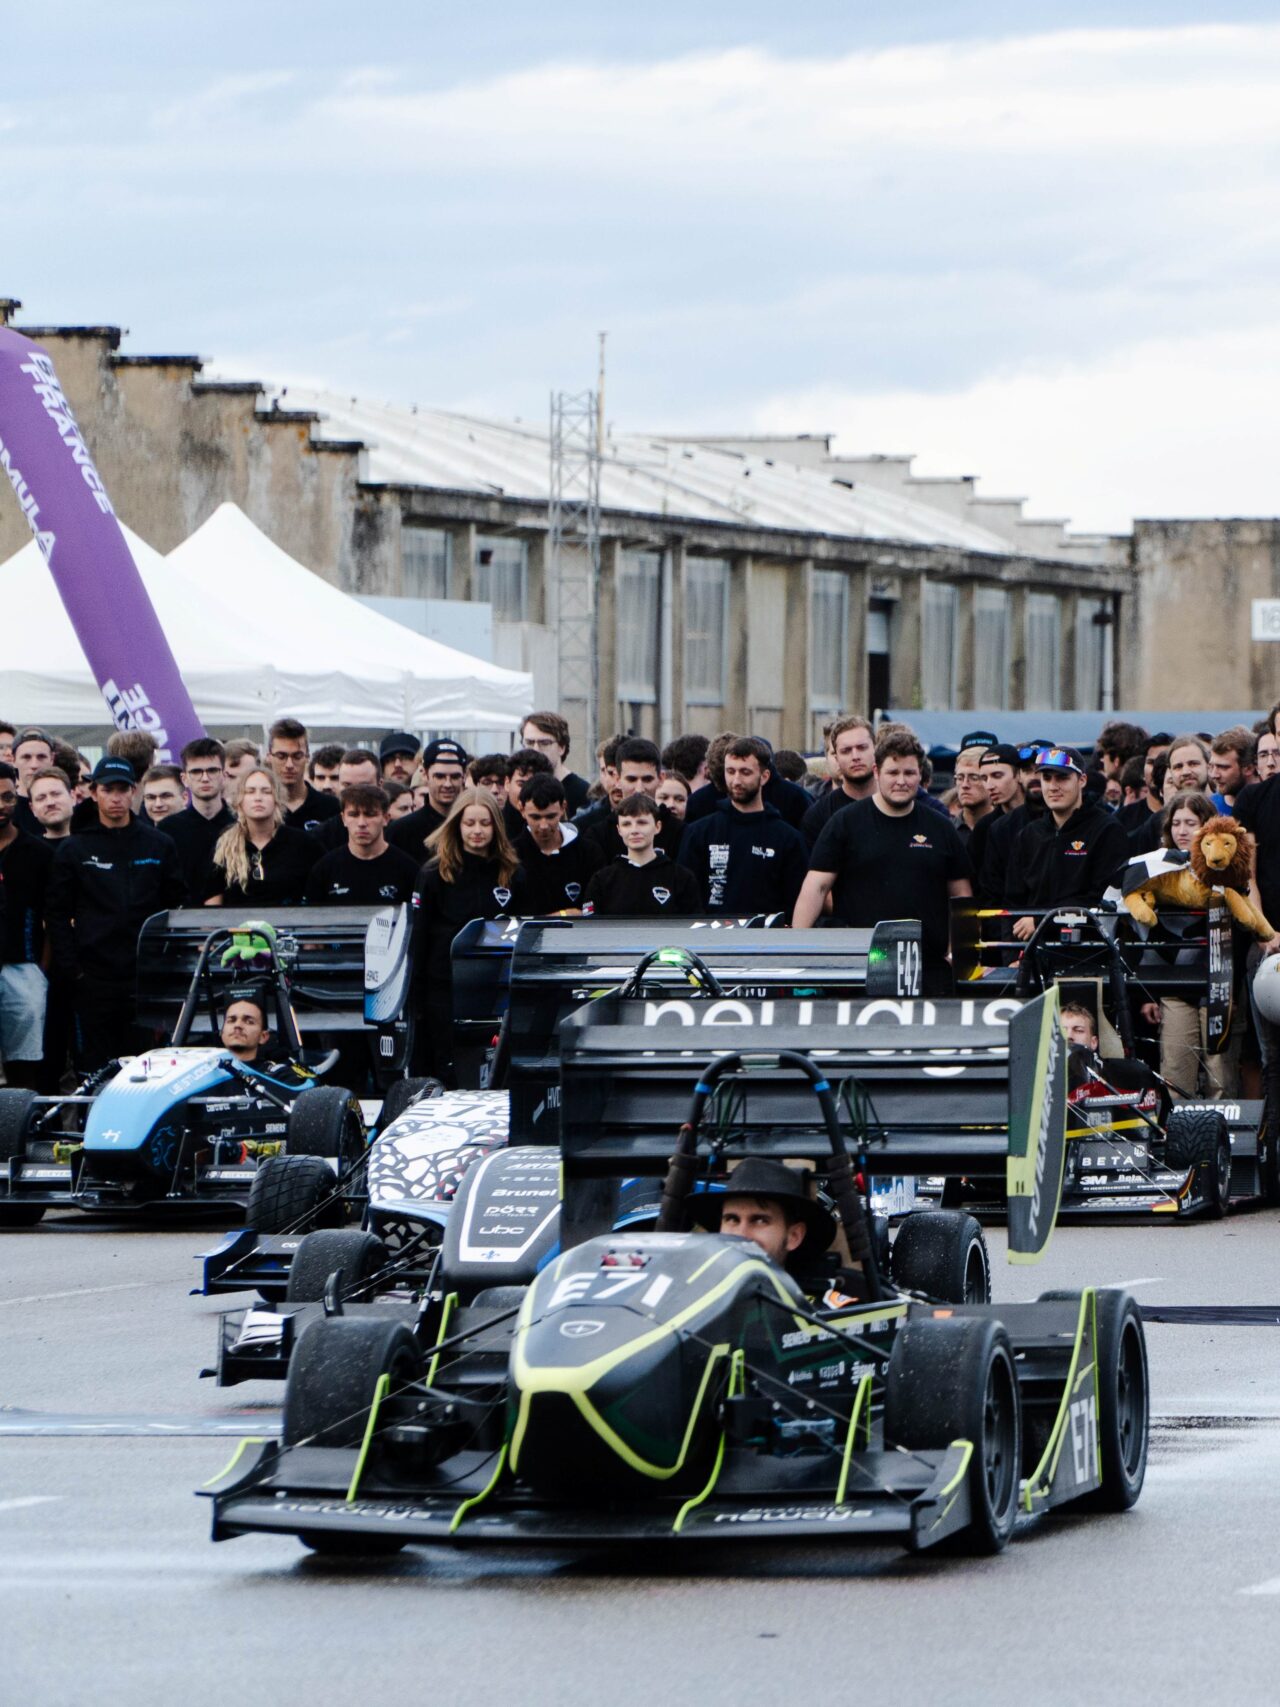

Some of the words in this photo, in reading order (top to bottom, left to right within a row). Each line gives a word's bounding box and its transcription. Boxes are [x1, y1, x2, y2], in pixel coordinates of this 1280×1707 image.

[20, 362, 114, 515] FRANCE
[897, 940, 919, 996] E42
[1080, 1175, 1107, 1185] 3M
[1081, 1157, 1134, 1167] BETA
[491, 1189, 558, 1197] Brunel
[546, 1271, 674, 1308] E71
[1070, 1394, 1098, 1485] E71
